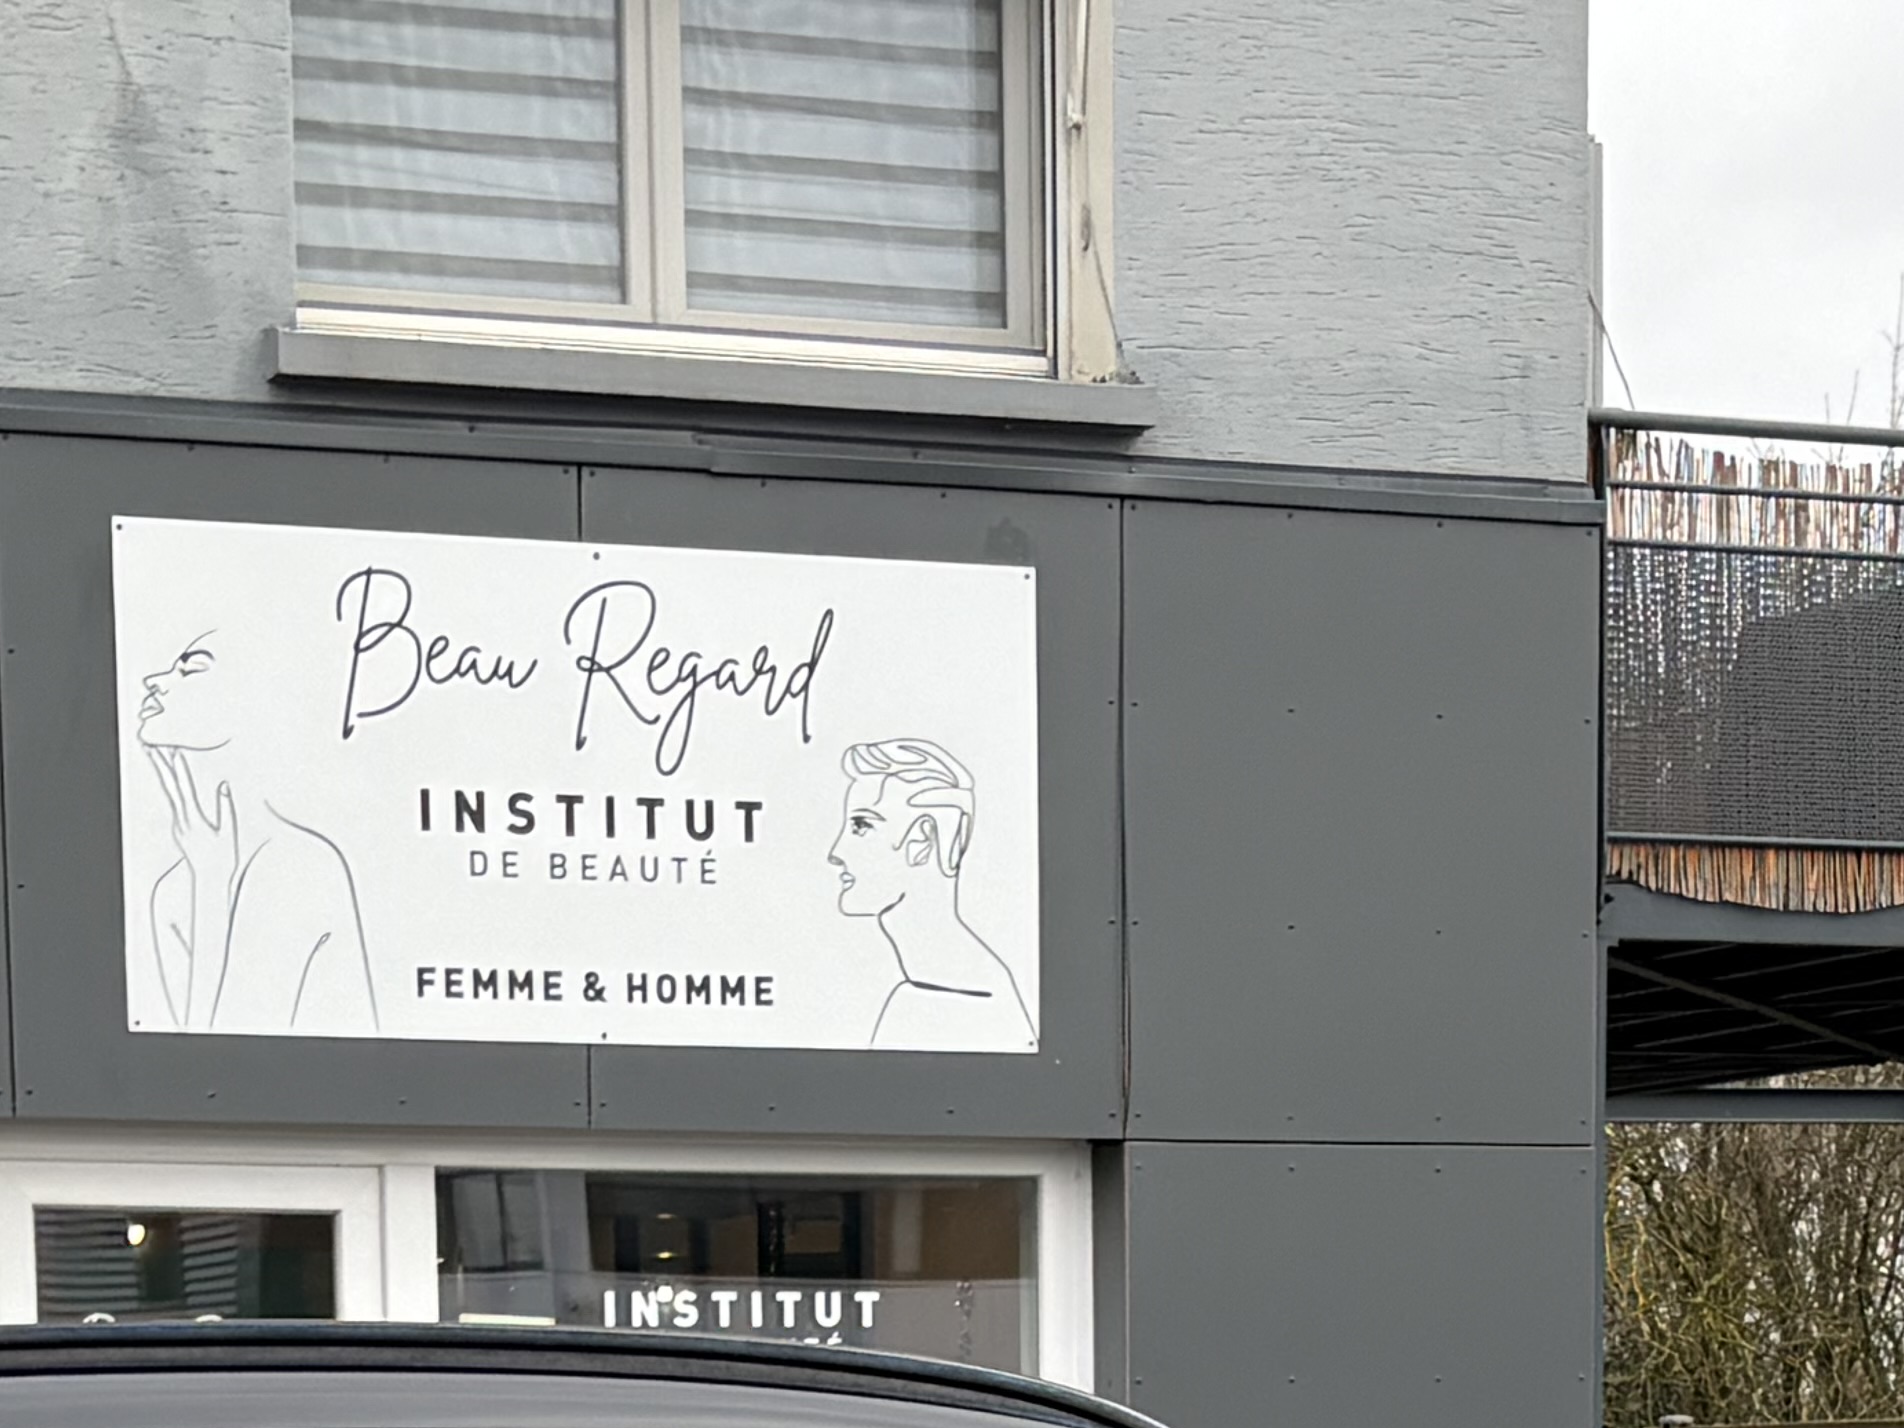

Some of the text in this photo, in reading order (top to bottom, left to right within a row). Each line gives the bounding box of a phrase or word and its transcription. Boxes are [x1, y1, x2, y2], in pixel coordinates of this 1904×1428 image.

[335, 566, 835, 776] Beau Regard
[419, 787, 764, 843] INSTITUT
[468, 848, 718, 886] DE BEAUTÉ
[416, 966, 775, 1006] FEMME & HOMME
[603, 1289, 881, 1328] INSTITUT
